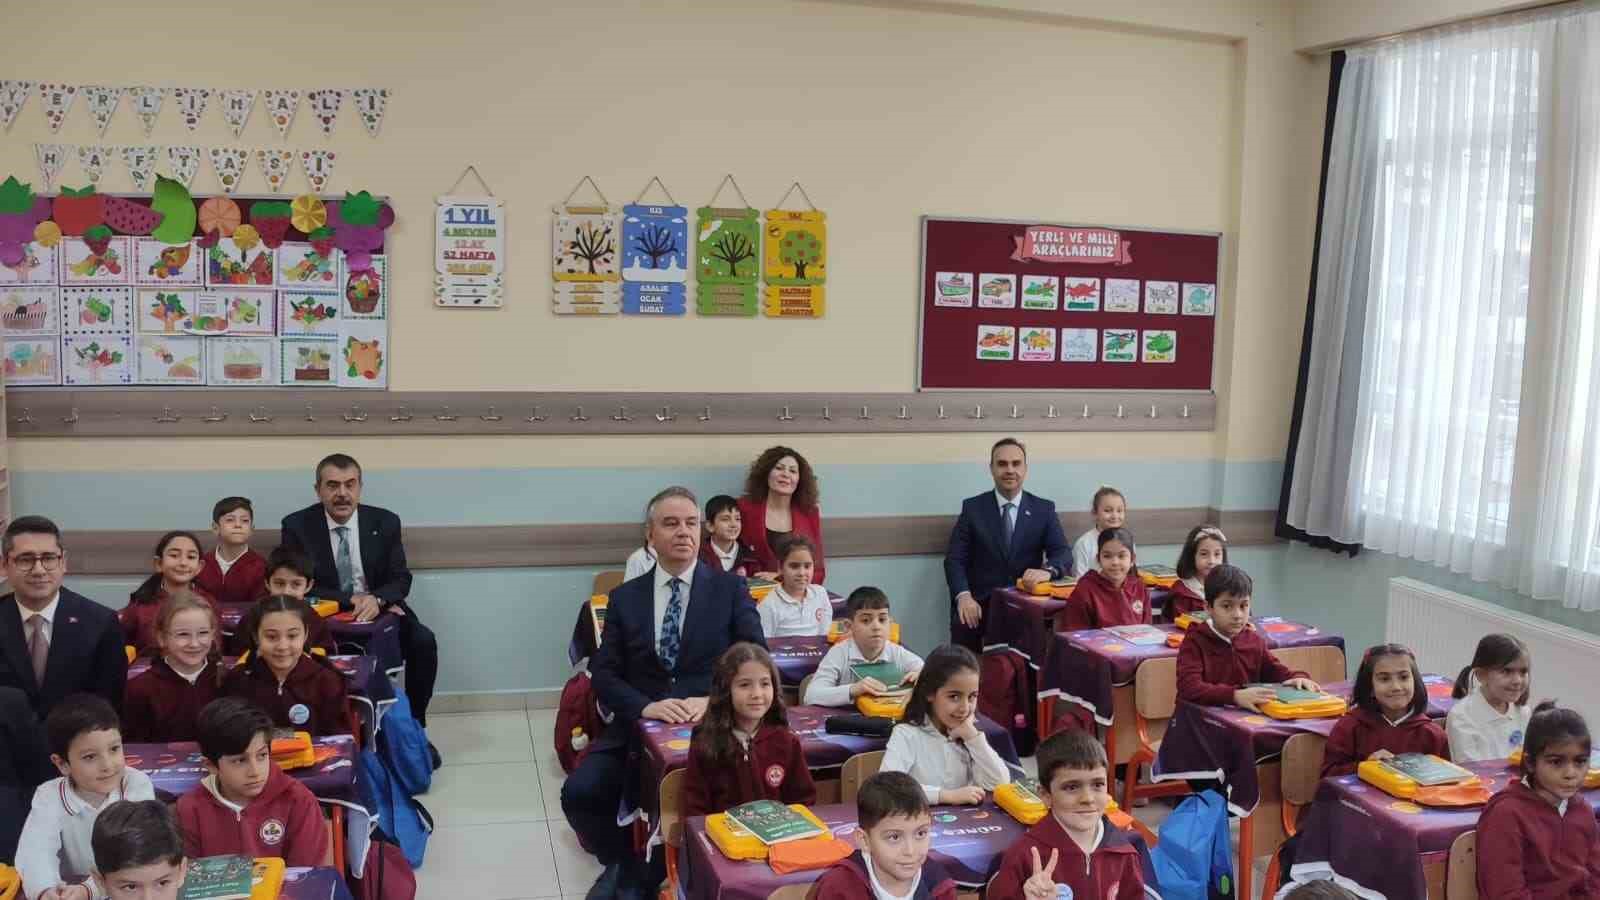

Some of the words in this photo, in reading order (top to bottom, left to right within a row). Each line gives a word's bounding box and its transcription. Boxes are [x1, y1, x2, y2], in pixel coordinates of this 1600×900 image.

[445, 208, 455, 224] 1
[462, 208, 496, 224] YIL
[1030, 231, 1065, 243] YERLİ
[1070, 232, 1083, 244] VE
[443, 250, 456, 260] 52
[459, 251, 497, 261] HAFTA
